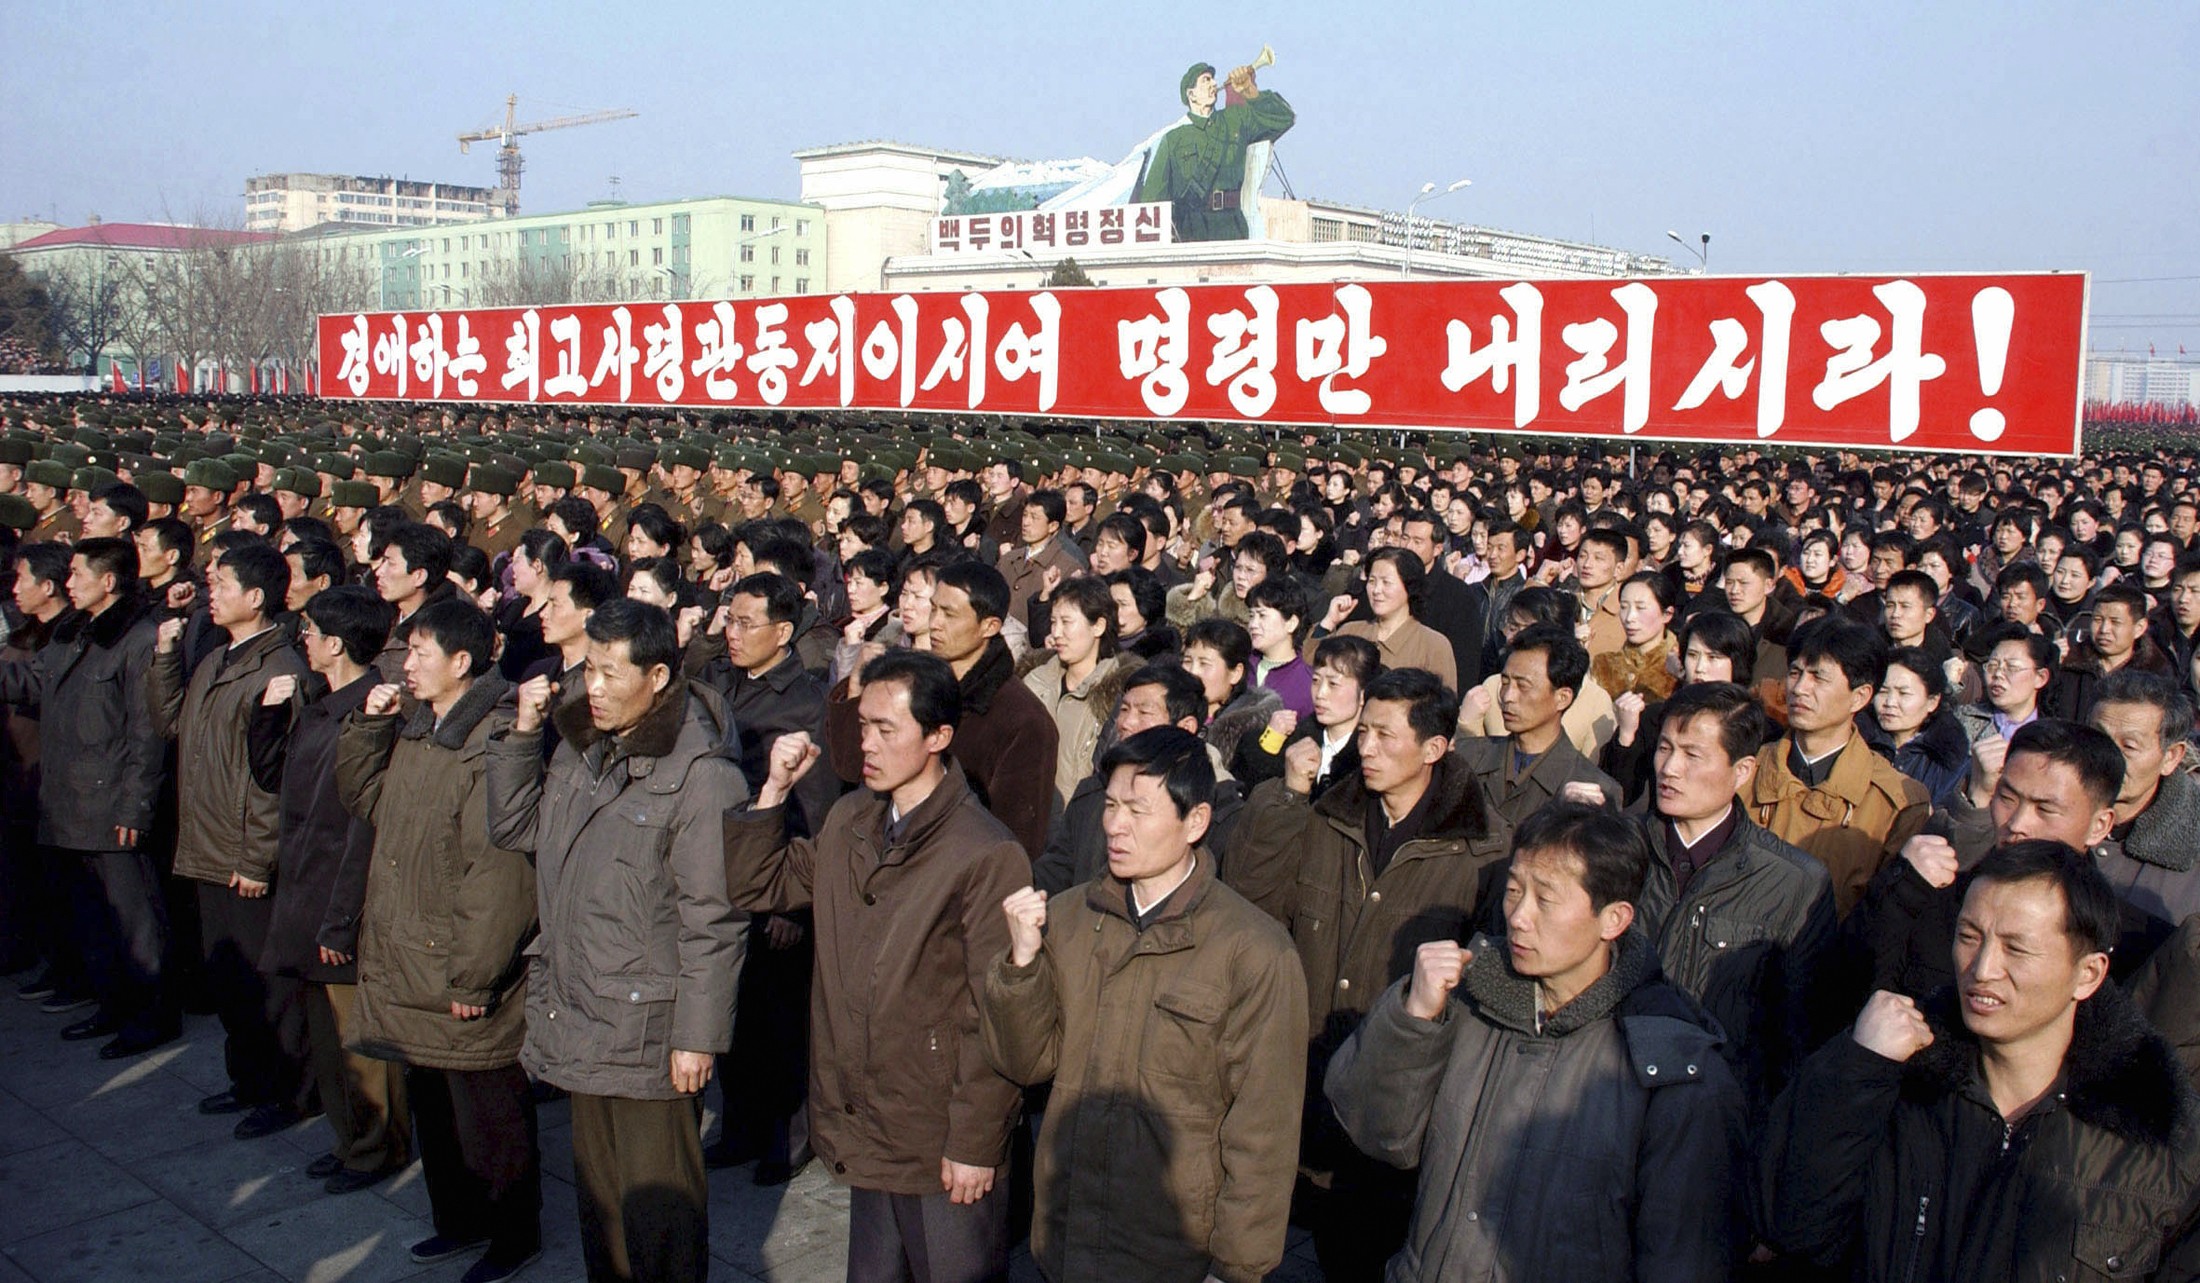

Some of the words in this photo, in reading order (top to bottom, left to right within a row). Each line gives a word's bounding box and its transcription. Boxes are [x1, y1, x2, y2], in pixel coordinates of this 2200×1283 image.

[337, 313, 488, 398] 경애하는
[501, 291, 1062, 412] 최고사령관동지이시여
[1117, 285, 1388, 417] 명령만
[1440, 280, 2016, 443] 내리시라!
